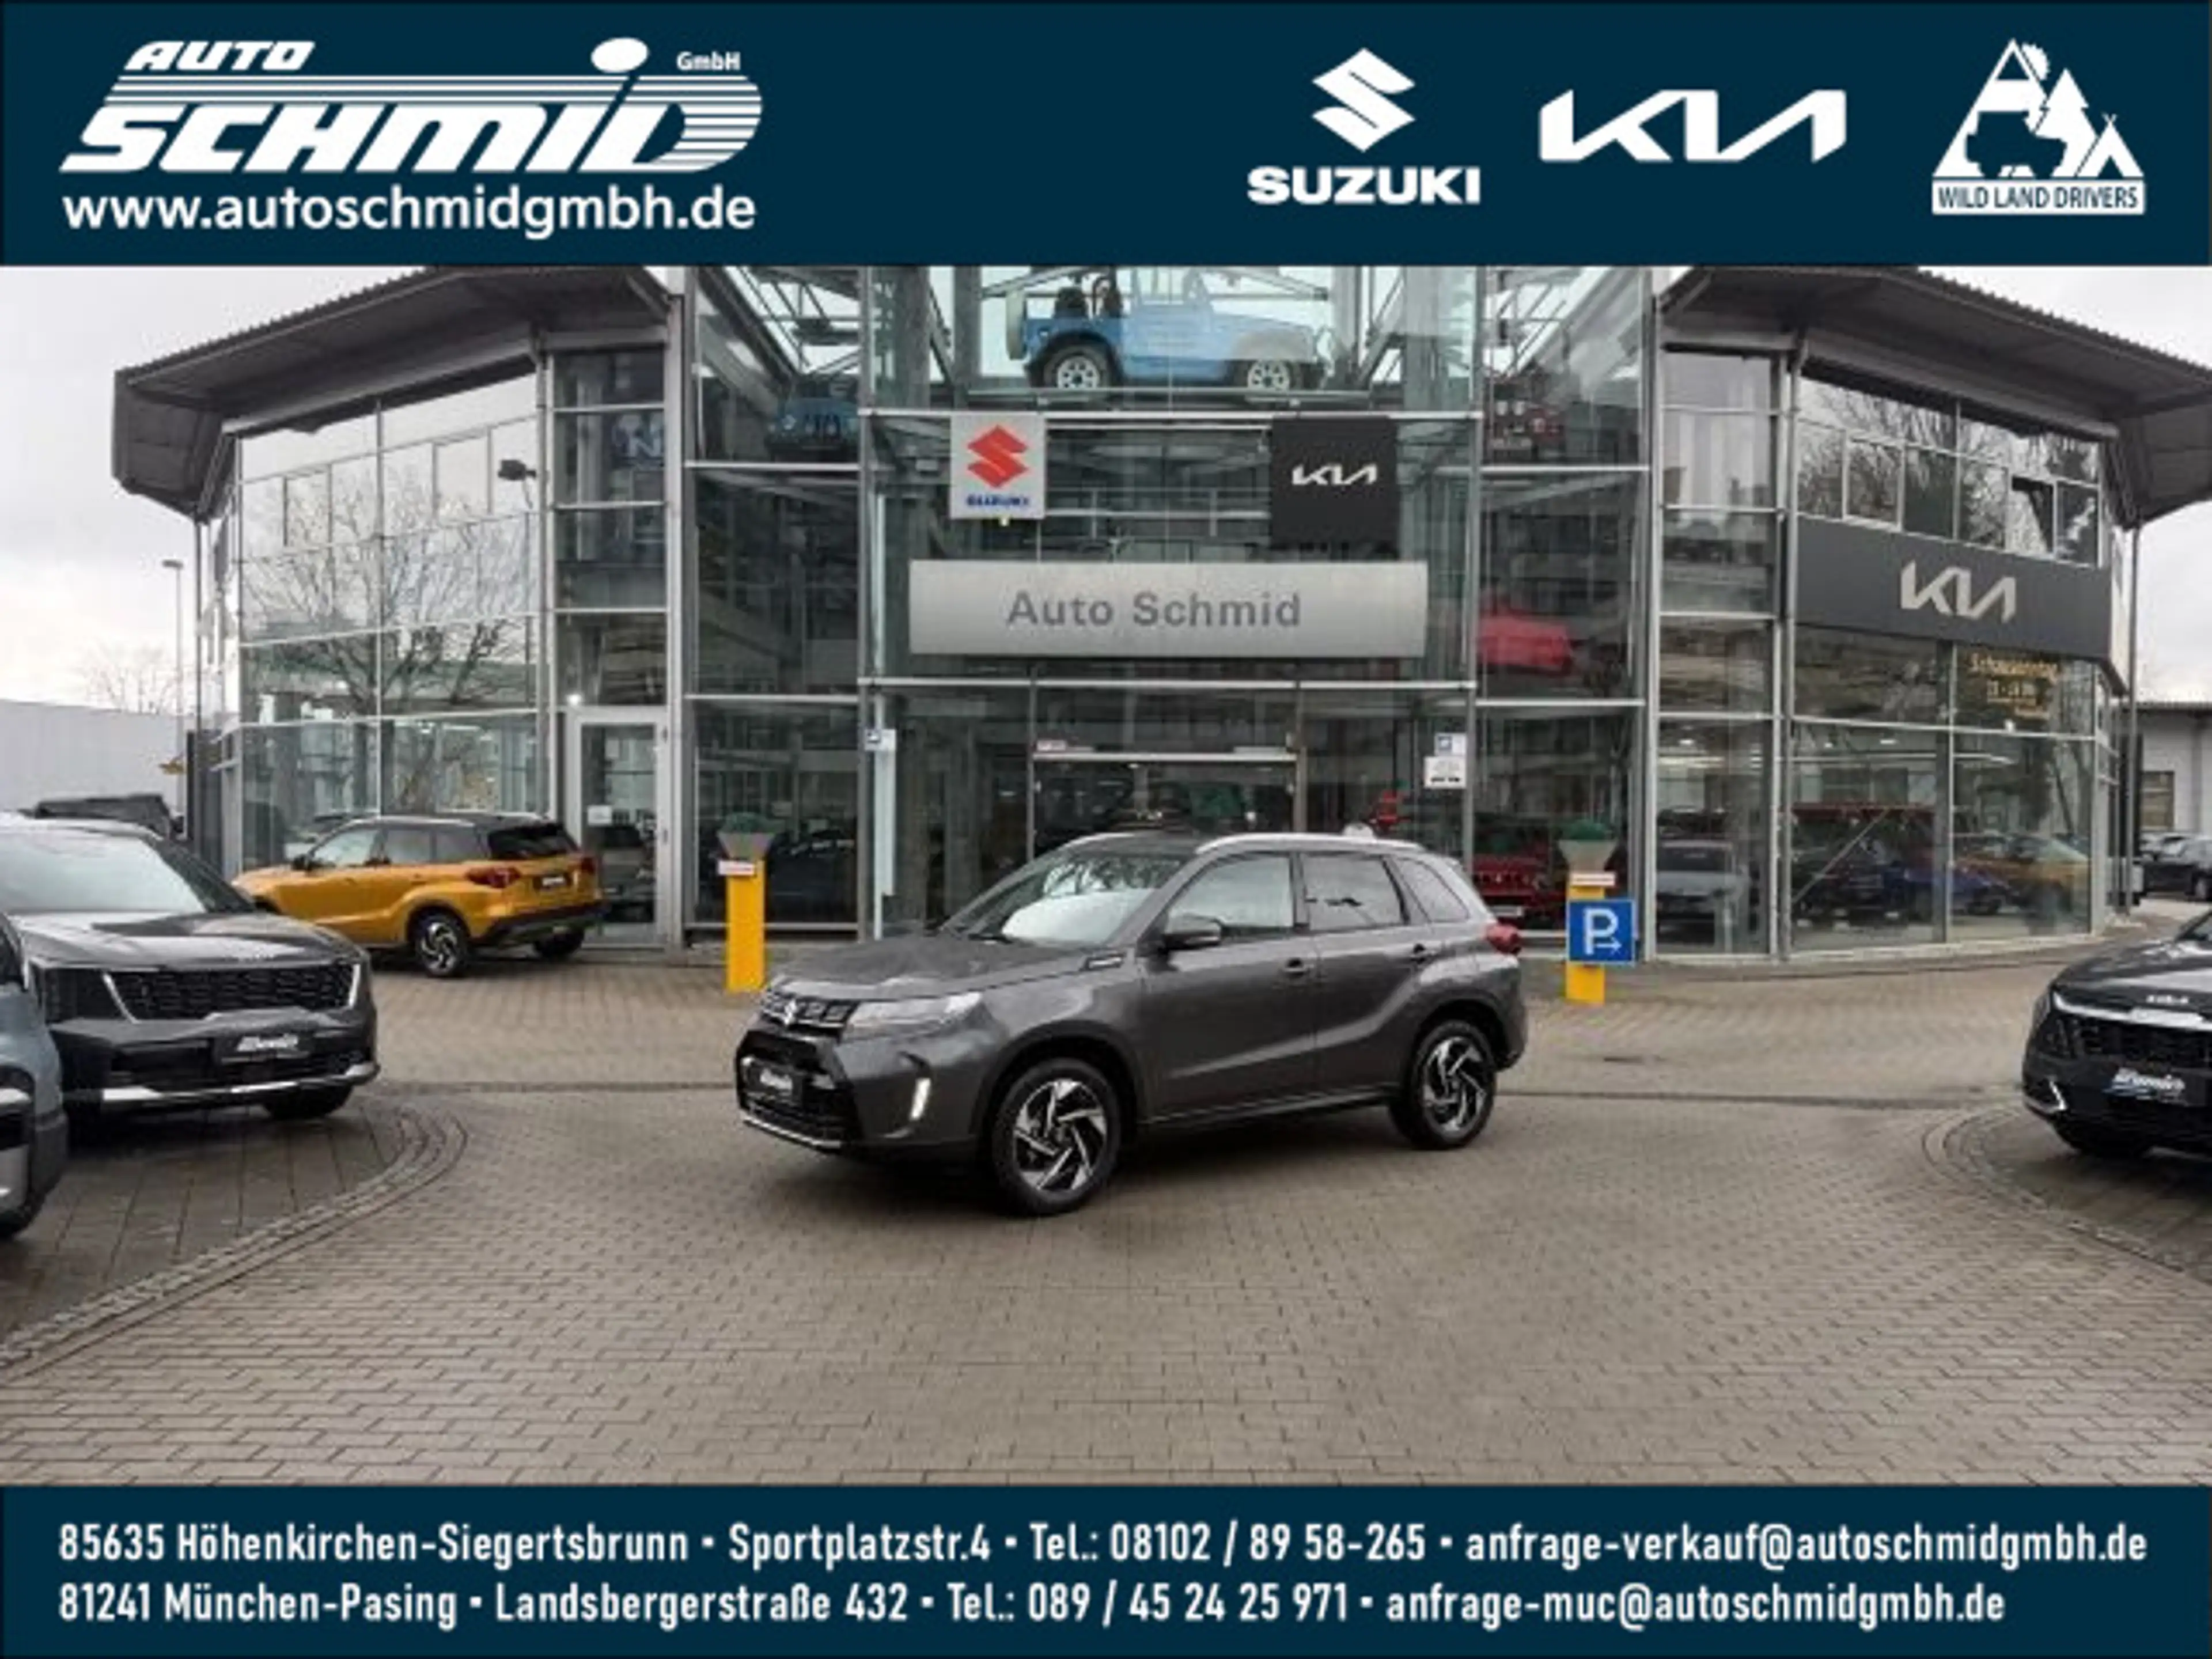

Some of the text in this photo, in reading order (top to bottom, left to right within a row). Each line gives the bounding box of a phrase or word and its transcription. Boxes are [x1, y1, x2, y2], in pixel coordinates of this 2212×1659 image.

[1292, 463, 1377, 486] KIA
[1006, 591, 1301, 627] Auto Schmid
[1900, 560, 2017, 623] KIA
[1584, 908, 1619, 955] P
